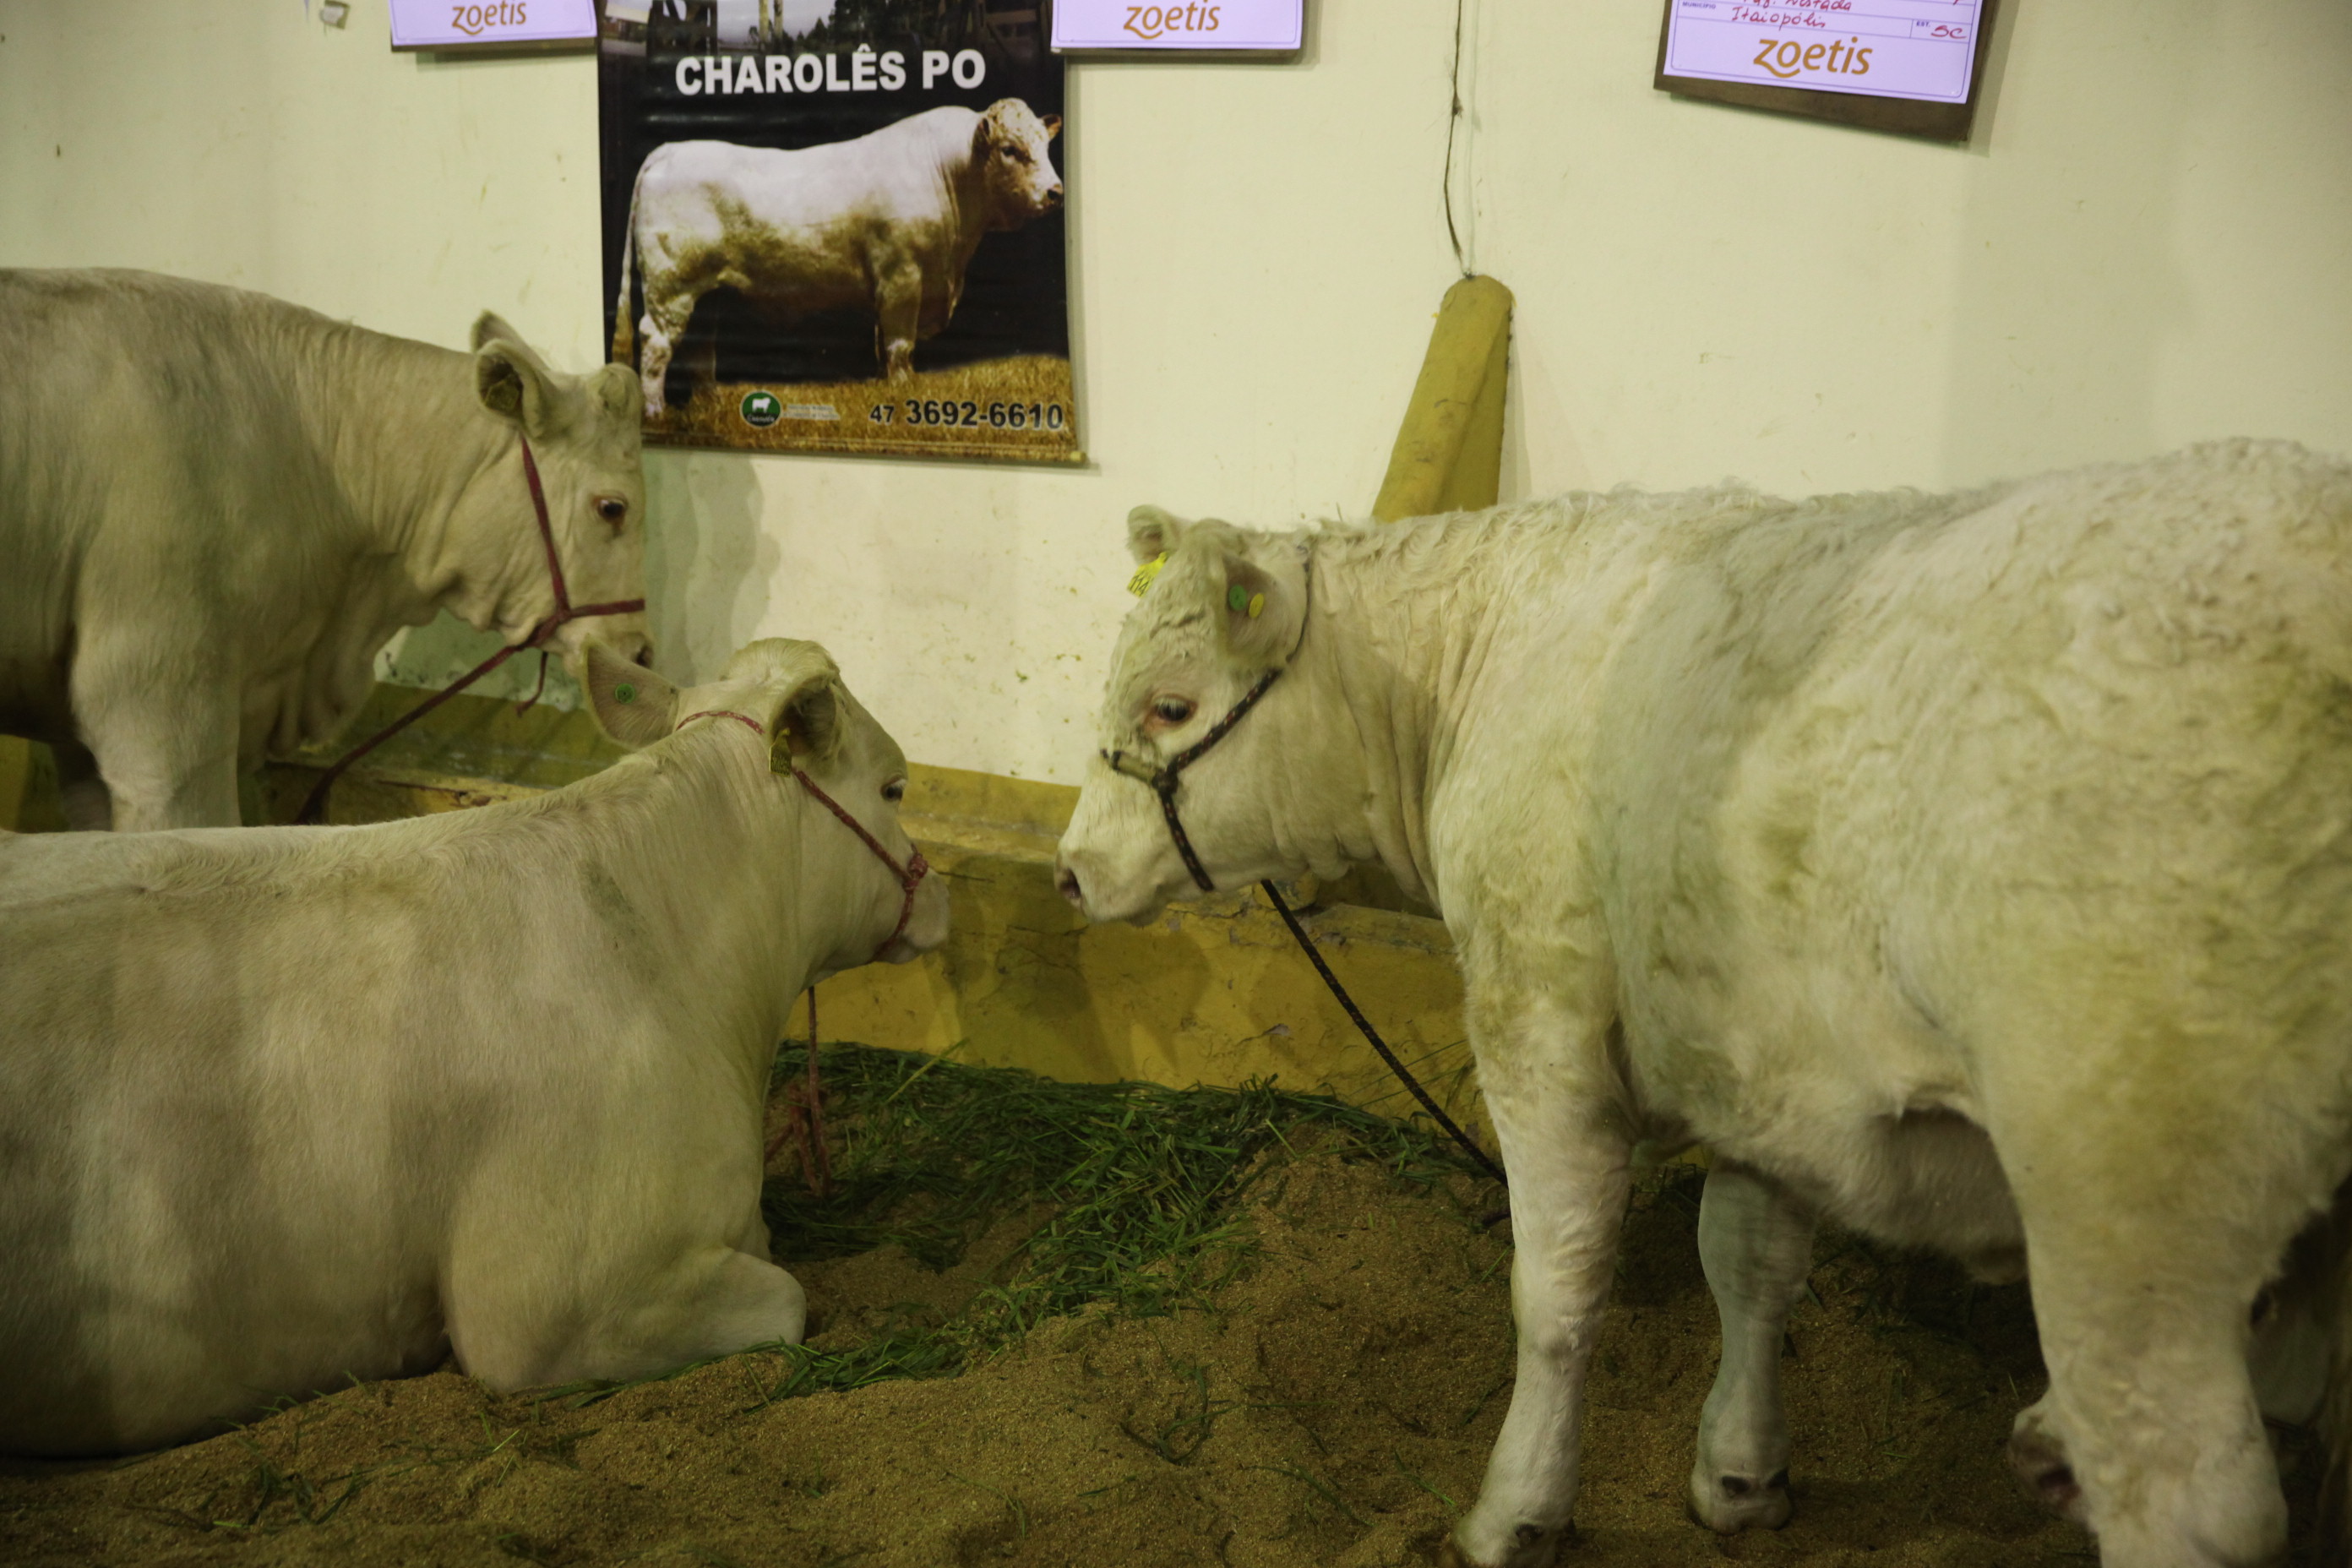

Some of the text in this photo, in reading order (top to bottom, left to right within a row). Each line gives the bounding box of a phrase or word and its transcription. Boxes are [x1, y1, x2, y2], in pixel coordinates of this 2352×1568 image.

[451, 0, 527, 35] zoetis
[1123, 0, 1221, 40] zoetis
[1930, 24, 1968, 39] SC
[676, 44, 986, 95] CHAROLÊS PO
[1752, 36, 1874, 79] zoetis
[869, 400, 1064, 429] 47 3692-6610
